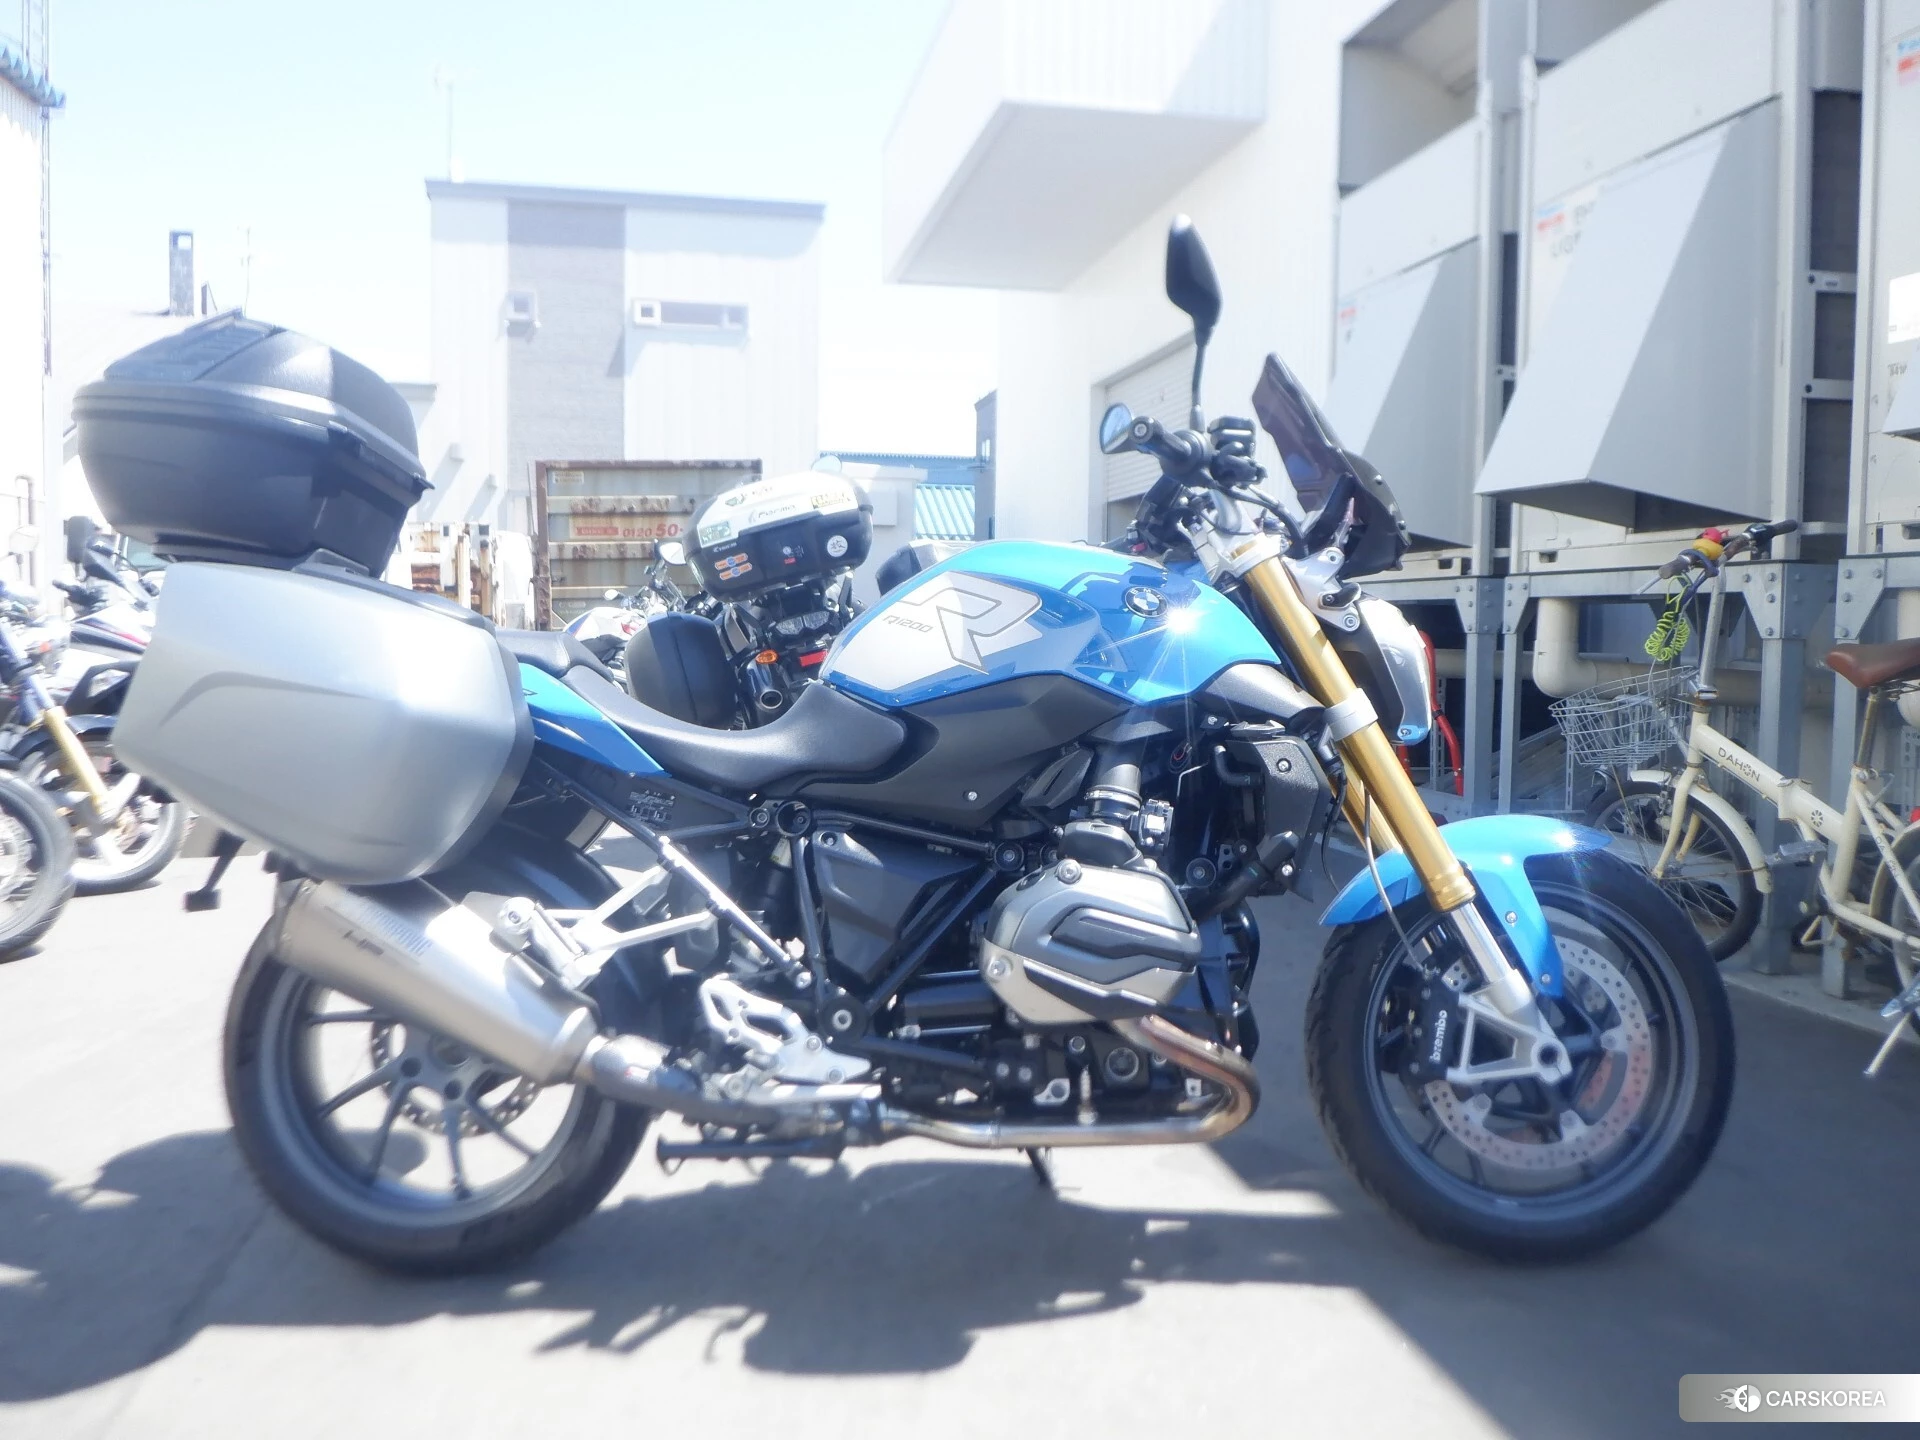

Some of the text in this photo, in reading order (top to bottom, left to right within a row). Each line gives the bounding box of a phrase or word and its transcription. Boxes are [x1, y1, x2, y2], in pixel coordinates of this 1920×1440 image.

[622, 527, 653, 538] 0120
[1718, 746, 1761, 782] DAHON
[1429, 1009, 1448, 1063] brembo
